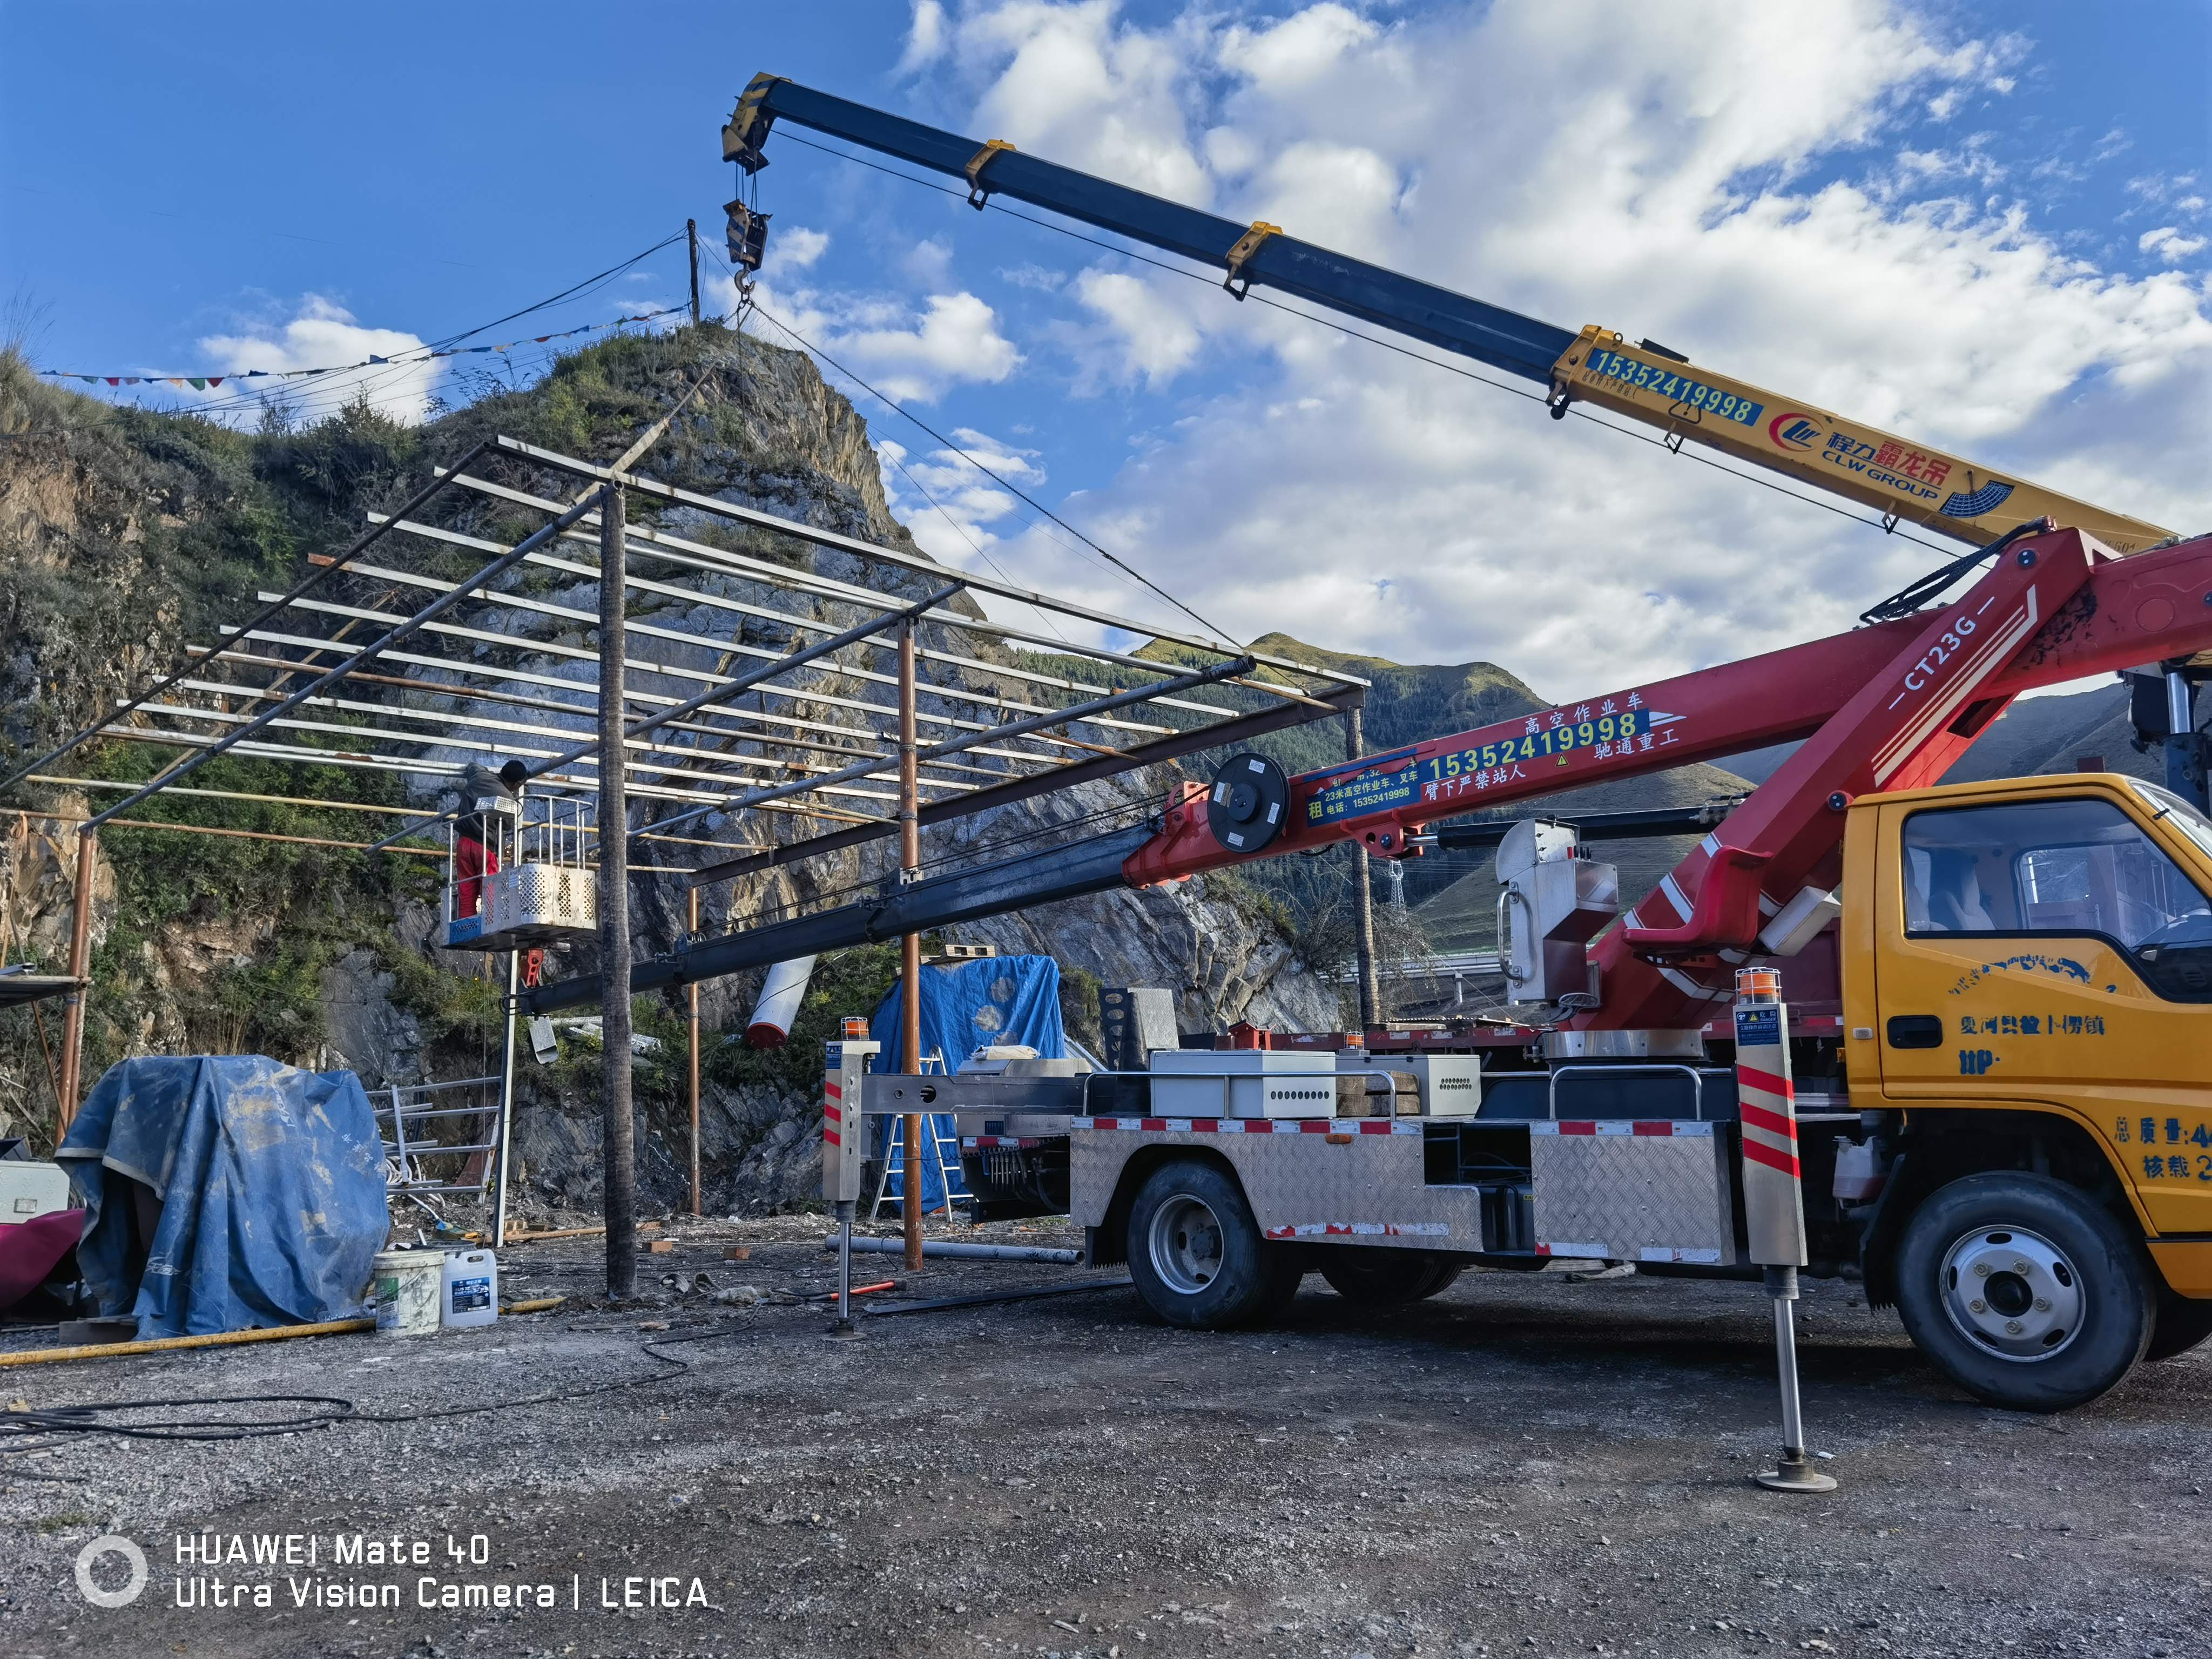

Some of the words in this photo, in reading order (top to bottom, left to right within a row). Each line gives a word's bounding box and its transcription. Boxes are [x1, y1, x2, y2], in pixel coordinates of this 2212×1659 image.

[1597, 352, 1752, 422] 15352419998
[1822, 450, 1866, 471] CLW
[1867, 468, 1938, 500] GROUP
[1826, 431, 1953, 486] 程力霸龙吊
[1525, 691, 1643, 735] 高空作业车
[1430, 713, 1636, 779] 15352419998
[1594, 729, 1679, 760] 驰通重工
[1353, 787, 1410, 808] 15352419998
[1425, 764, 1526, 801] 臂下严禁站人
[1309, 801, 1323, 819] 租
